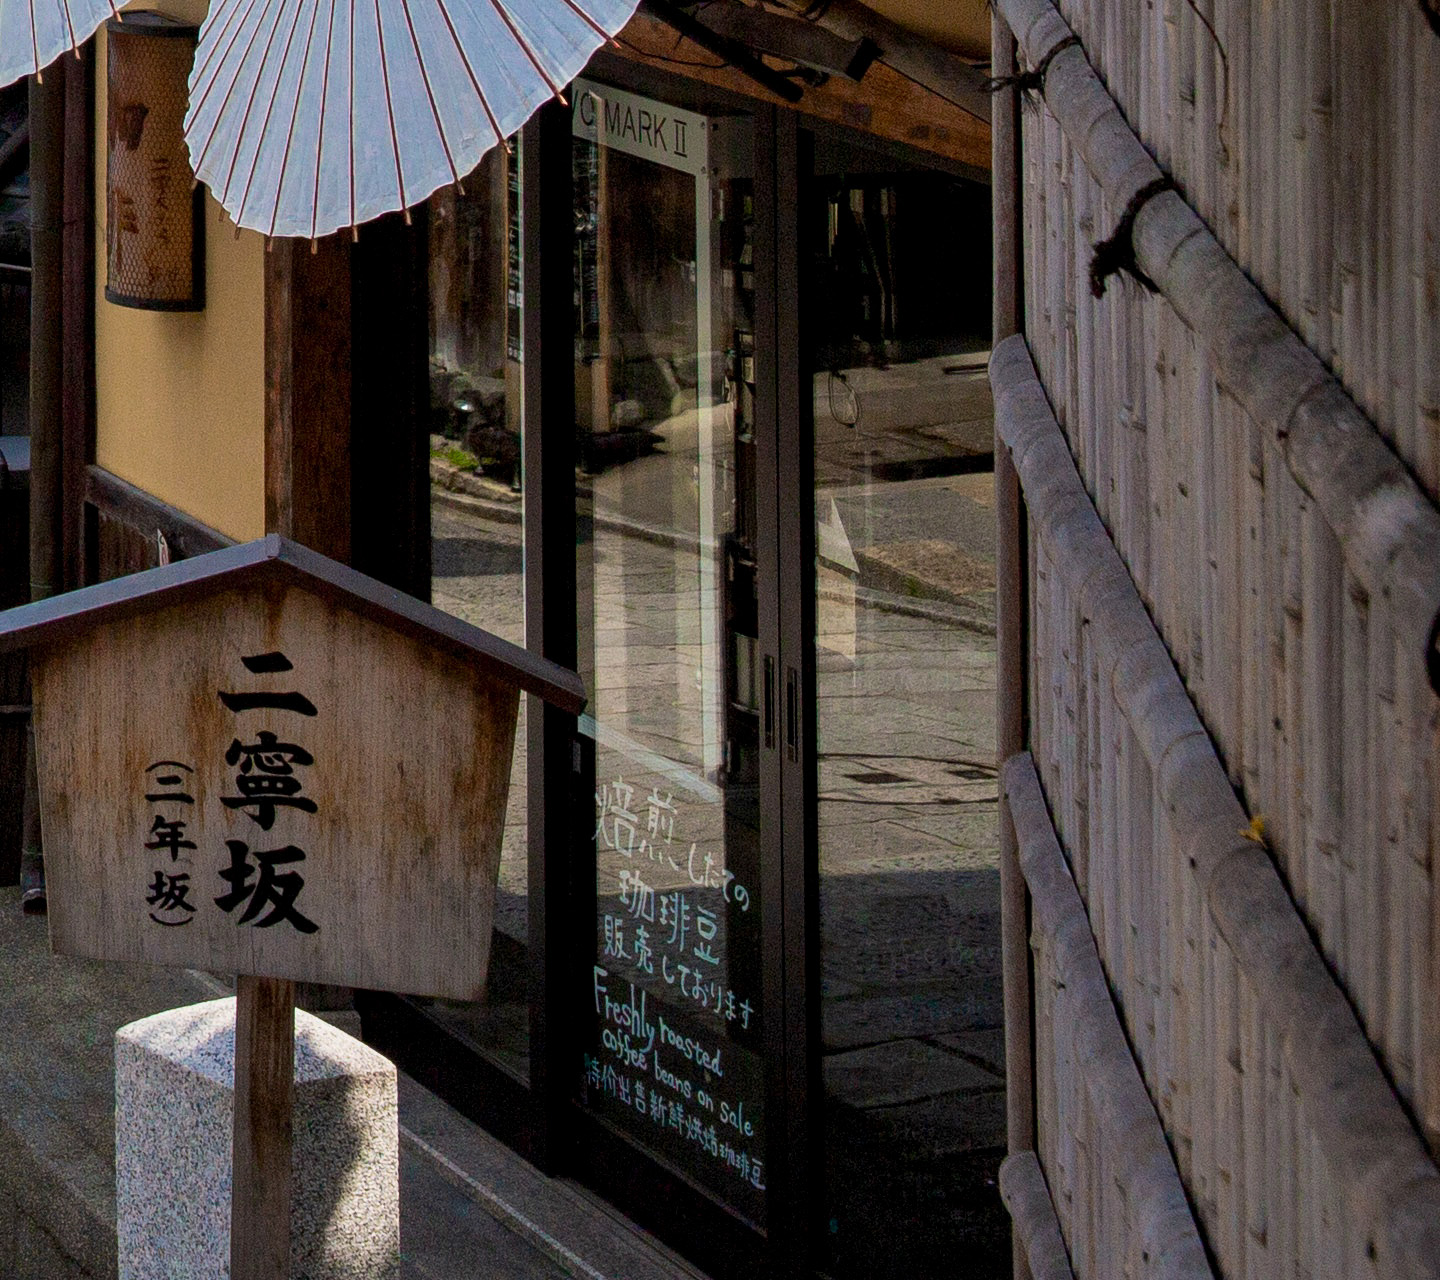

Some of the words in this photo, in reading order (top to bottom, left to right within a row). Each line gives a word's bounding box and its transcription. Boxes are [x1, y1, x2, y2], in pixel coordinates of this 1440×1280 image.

[604, 98, 668, 152] MARK
[214, 650, 320, 935] 二寧坂
[591, 775, 749, 912] 焙煎したての
[604, 914, 755, 1029] 販売しております
[618, 870, 721, 965] 珈琲豆
[593, 965, 655, 1054] Freshly
[658, 1016, 724, 1077] roasted
[602, 1028, 648, 1071] coffee
[653, 1049, 692, 1099] beans
[697, 1090, 715, 1113] on
